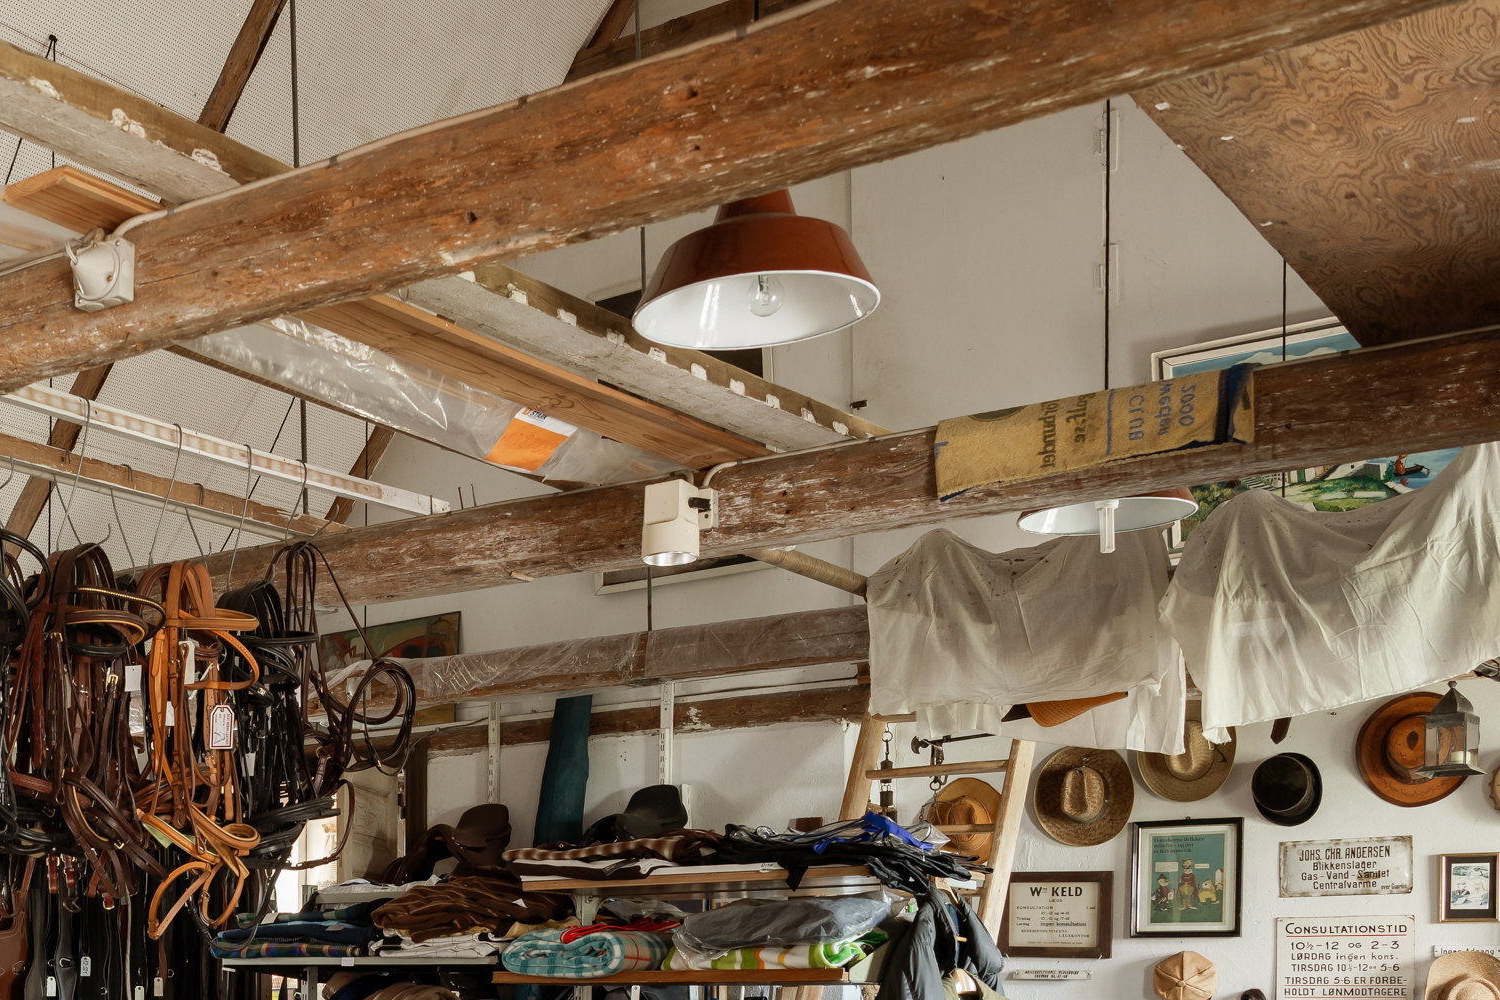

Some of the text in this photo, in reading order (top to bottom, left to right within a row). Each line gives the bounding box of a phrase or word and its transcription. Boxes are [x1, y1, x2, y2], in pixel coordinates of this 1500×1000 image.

[1299, 845, 1390, 861] JOHS. CHR. ANDERSEN
[1313, 861, 1377, 871] Blikkenslager
[1301, 872, 1318, 881] Gas
[1326, 871, 1349, 880] Vand
[1313, 880, 1377, 890] Centralvarme
[1051, 886, 1083, 897] KELD
[1291, 952, 1331, 961] LØRDAG
[1336, 952, 1366, 962] ingen
[1292, 963, 1334, 972] TIRSDAG
[1285, 976, 1329, 985] TIRSDAG
[1354, 976, 1366, 984] ER
[1369, 976, 1408, 984] FORBE-
[1284, 987, 1407, 996] HOLDT LØNMODTAGERE
